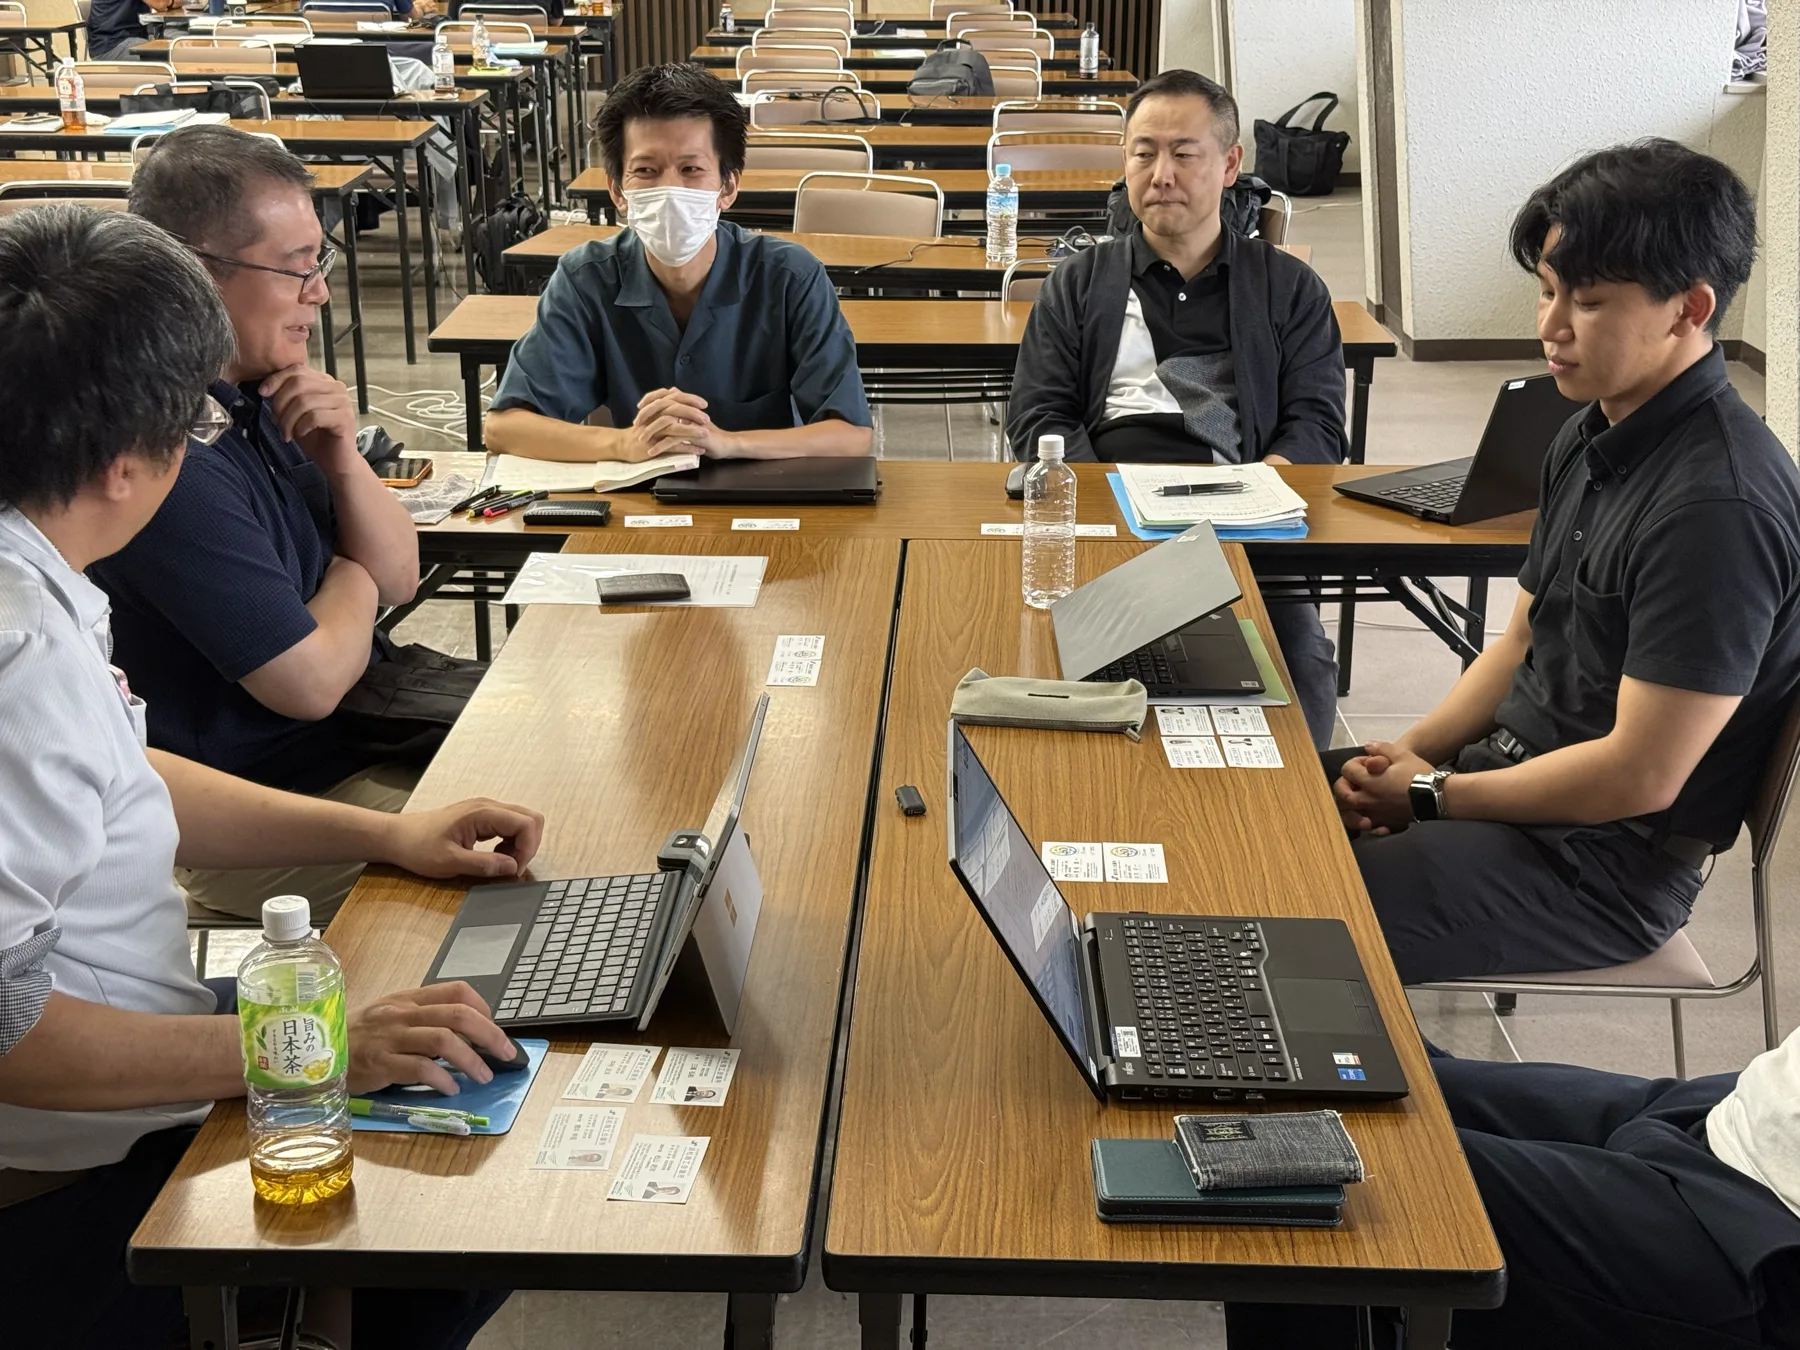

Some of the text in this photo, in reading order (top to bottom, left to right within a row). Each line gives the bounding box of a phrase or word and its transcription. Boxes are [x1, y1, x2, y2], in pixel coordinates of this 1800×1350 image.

[282, 1019, 303, 1074] 日本茶
[303, 1018, 316, 1052] 旨みの
